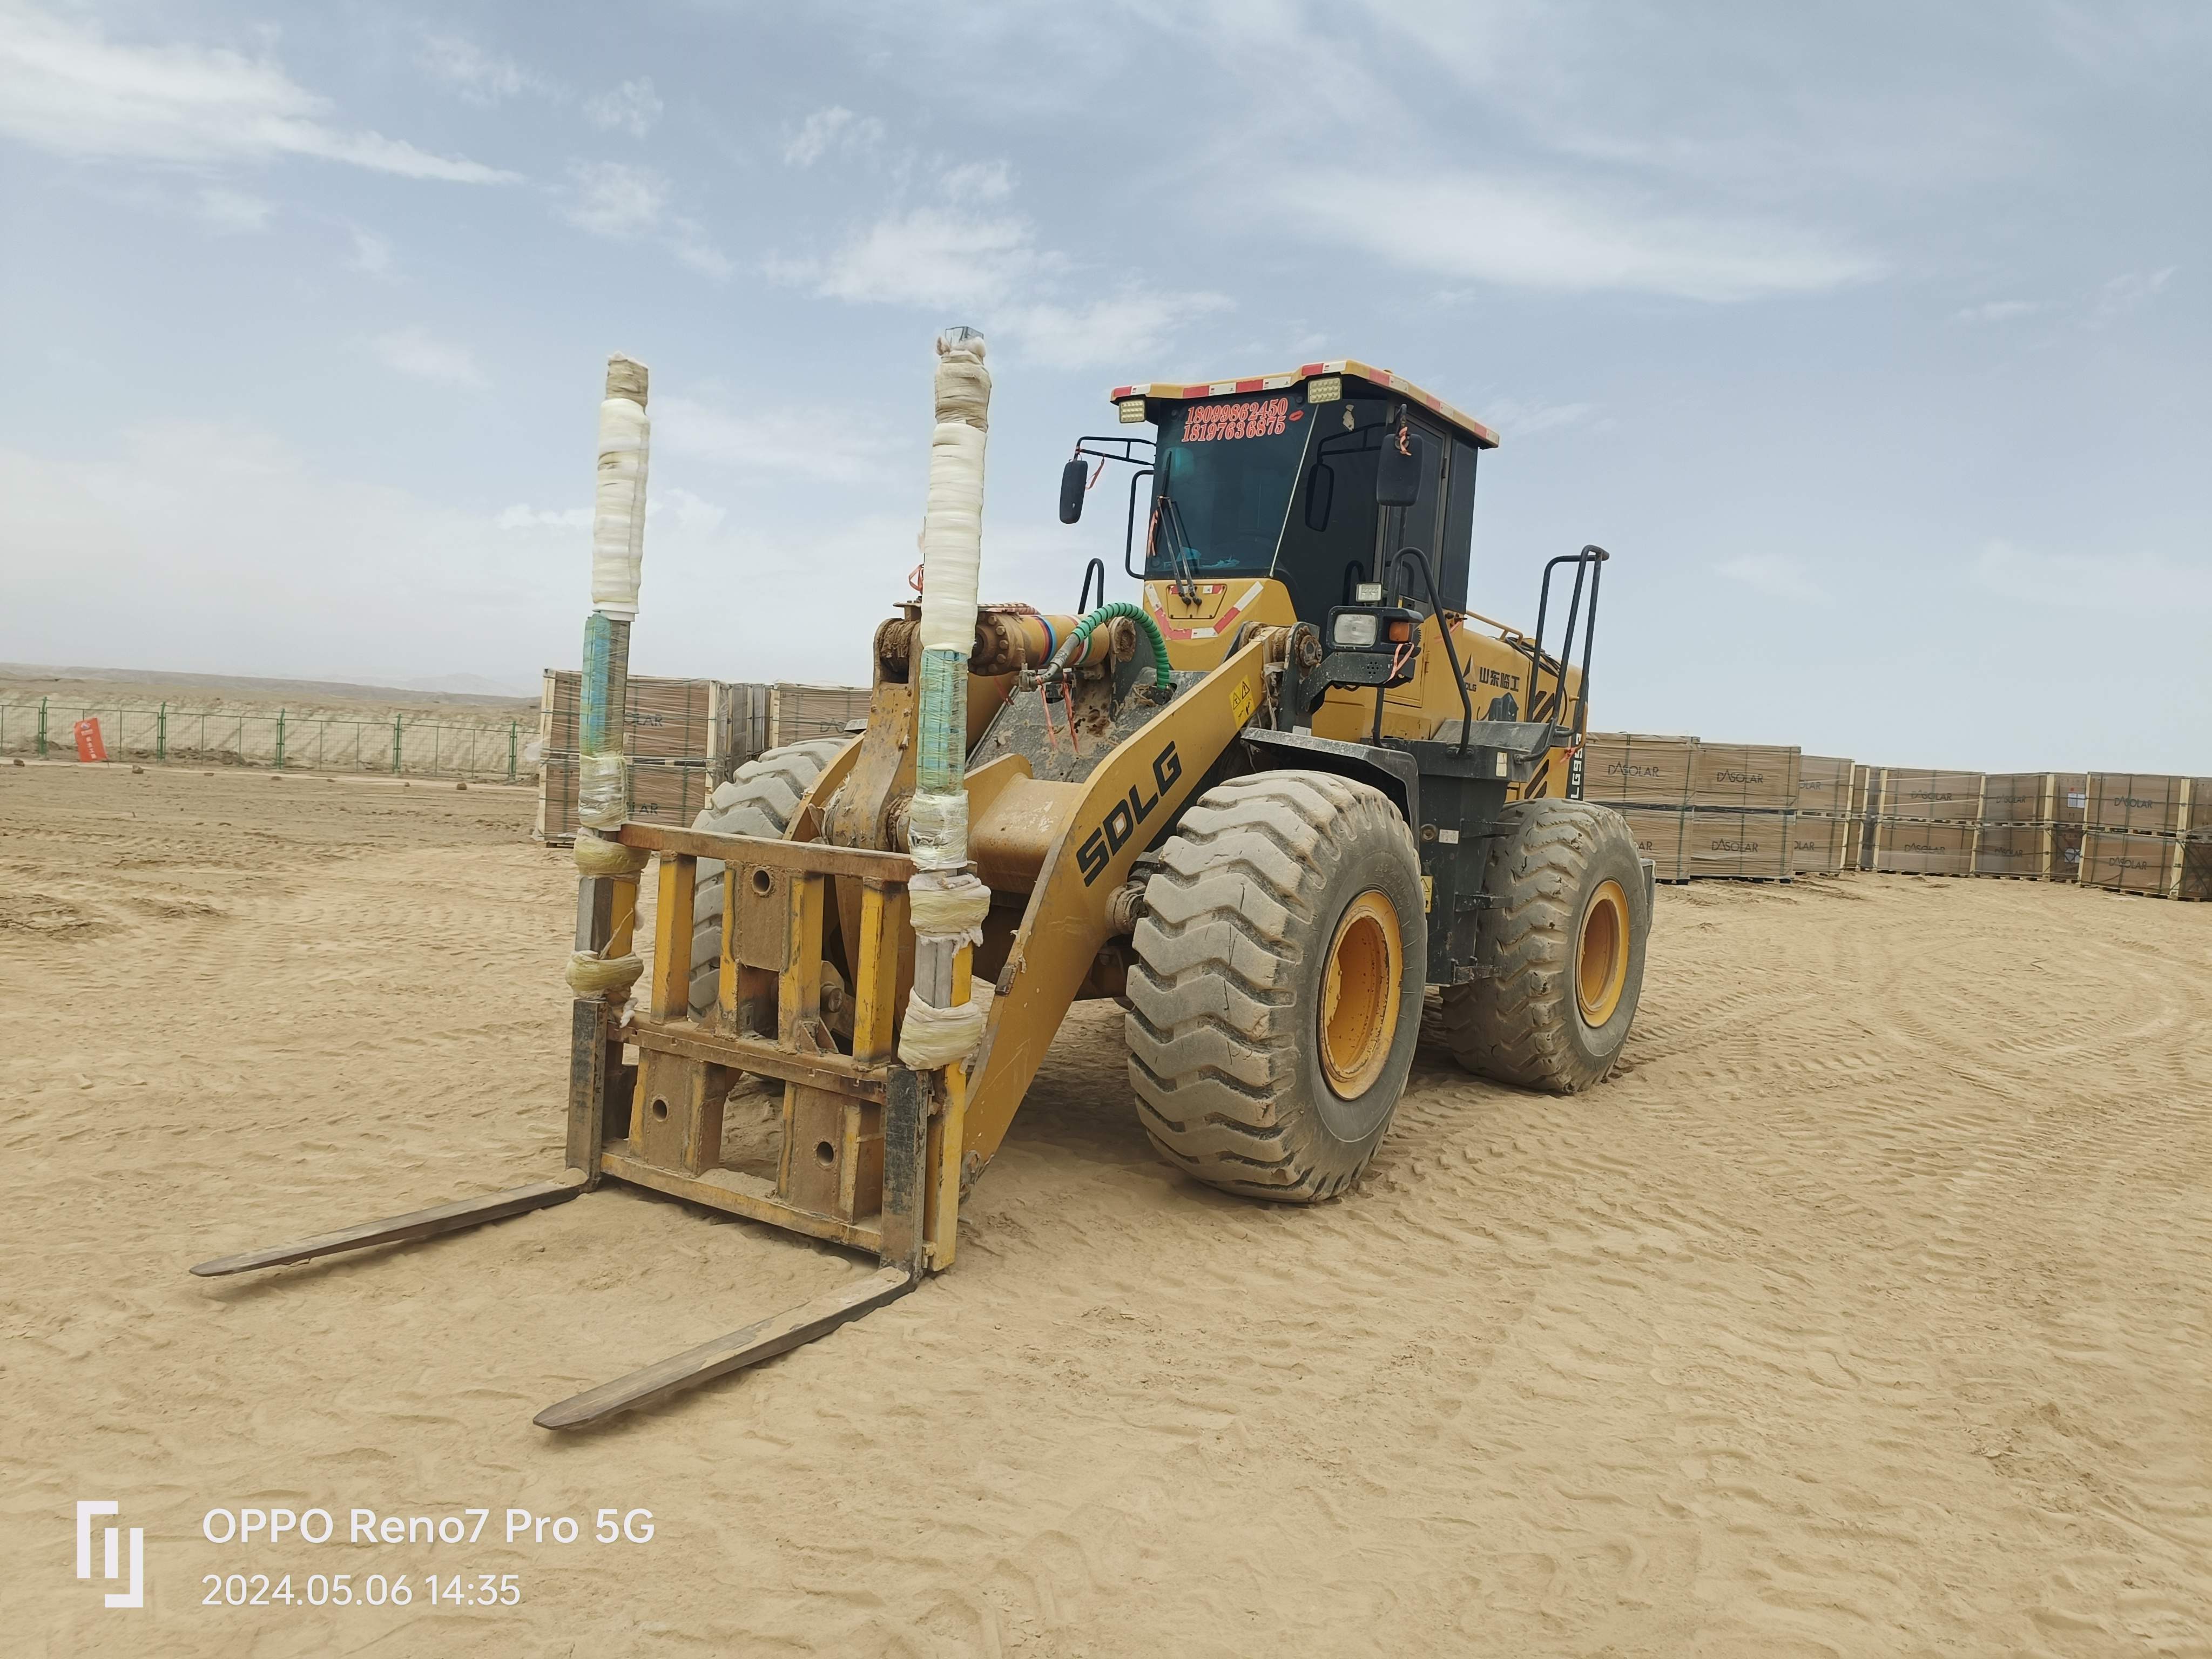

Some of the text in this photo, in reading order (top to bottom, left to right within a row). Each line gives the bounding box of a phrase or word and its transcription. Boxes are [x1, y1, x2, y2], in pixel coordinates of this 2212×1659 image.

[1185, 397, 1288, 424] 18099862450
[1182, 416, 1286, 442] 18197636875
[1464, 682, 1477, 692] DLG
[1479, 666, 1520, 692] 山东临工
[1608, 761, 1659, 777] DASOLAR
[1717, 769, 1763, 784] DASOLAR
[1076, 740, 1182, 887] SDLG
[1711, 838, 1758, 852] DASOLAR
